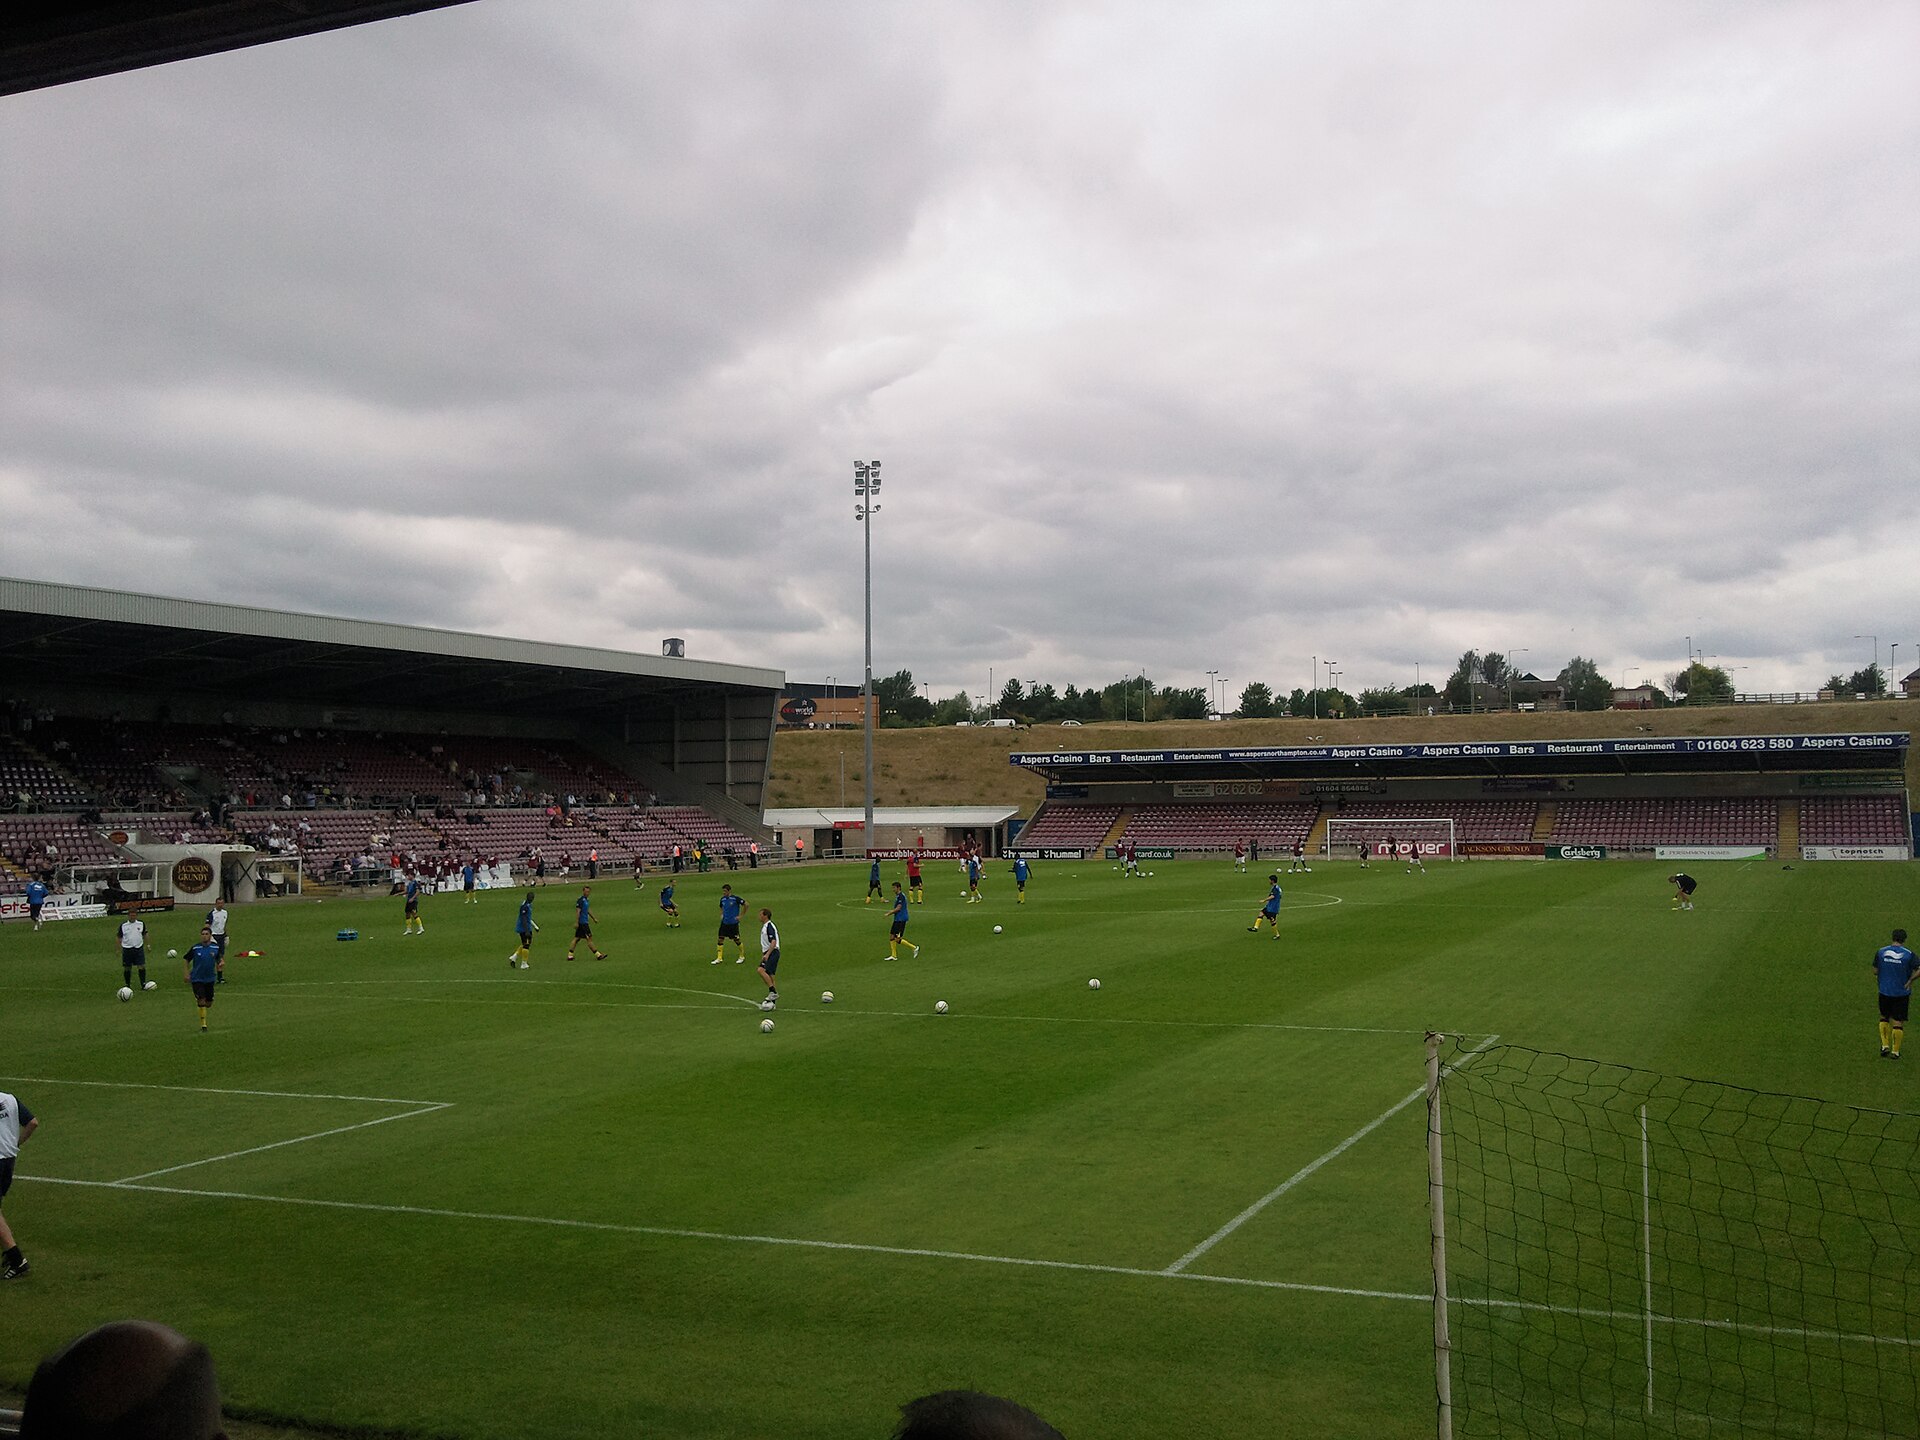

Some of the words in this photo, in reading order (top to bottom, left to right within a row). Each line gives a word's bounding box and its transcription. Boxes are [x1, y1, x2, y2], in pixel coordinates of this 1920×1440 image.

[1614, 742, 1676, 751] Entertainment
[1697, 740, 1737, 750] 01604
[1741, 739, 1765, 749] 623
[1769, 739, 1794, 748] 580
[1801, 737, 1845, 748] Aspers
[1849, 736, 1892, 746] Casino
[1229, 749, 1326, 757] www.aspersnorthampton.co.uk
[1331, 748, 1366, 758] Aspers
[1368, 747, 1403, 757] Casino
[1422, 746, 1460, 756] Aspers
[1462, 745, 1501, 755] Casino
[1509, 745, 1535, 755] Bars
[1547, 744, 1603, 754] Restaurant
[1020, 755, 1051, 765] Aspers
[1052, 754, 1083, 763] Casino
[1089, 754, 1111, 763] Bars
[1121, 753, 1164, 762] Restaurant
[1174, 752, 1222, 761] Entertainment
[871, 849, 960, 859] www.cobbles-shop.co.u
[1050, 850, 1083, 859] hummel
[1560, 845, 1601, 859] Carlsberg
[178, 865, 209, 873] JACKSON
[178, 873, 208, 881] GRUNDY
